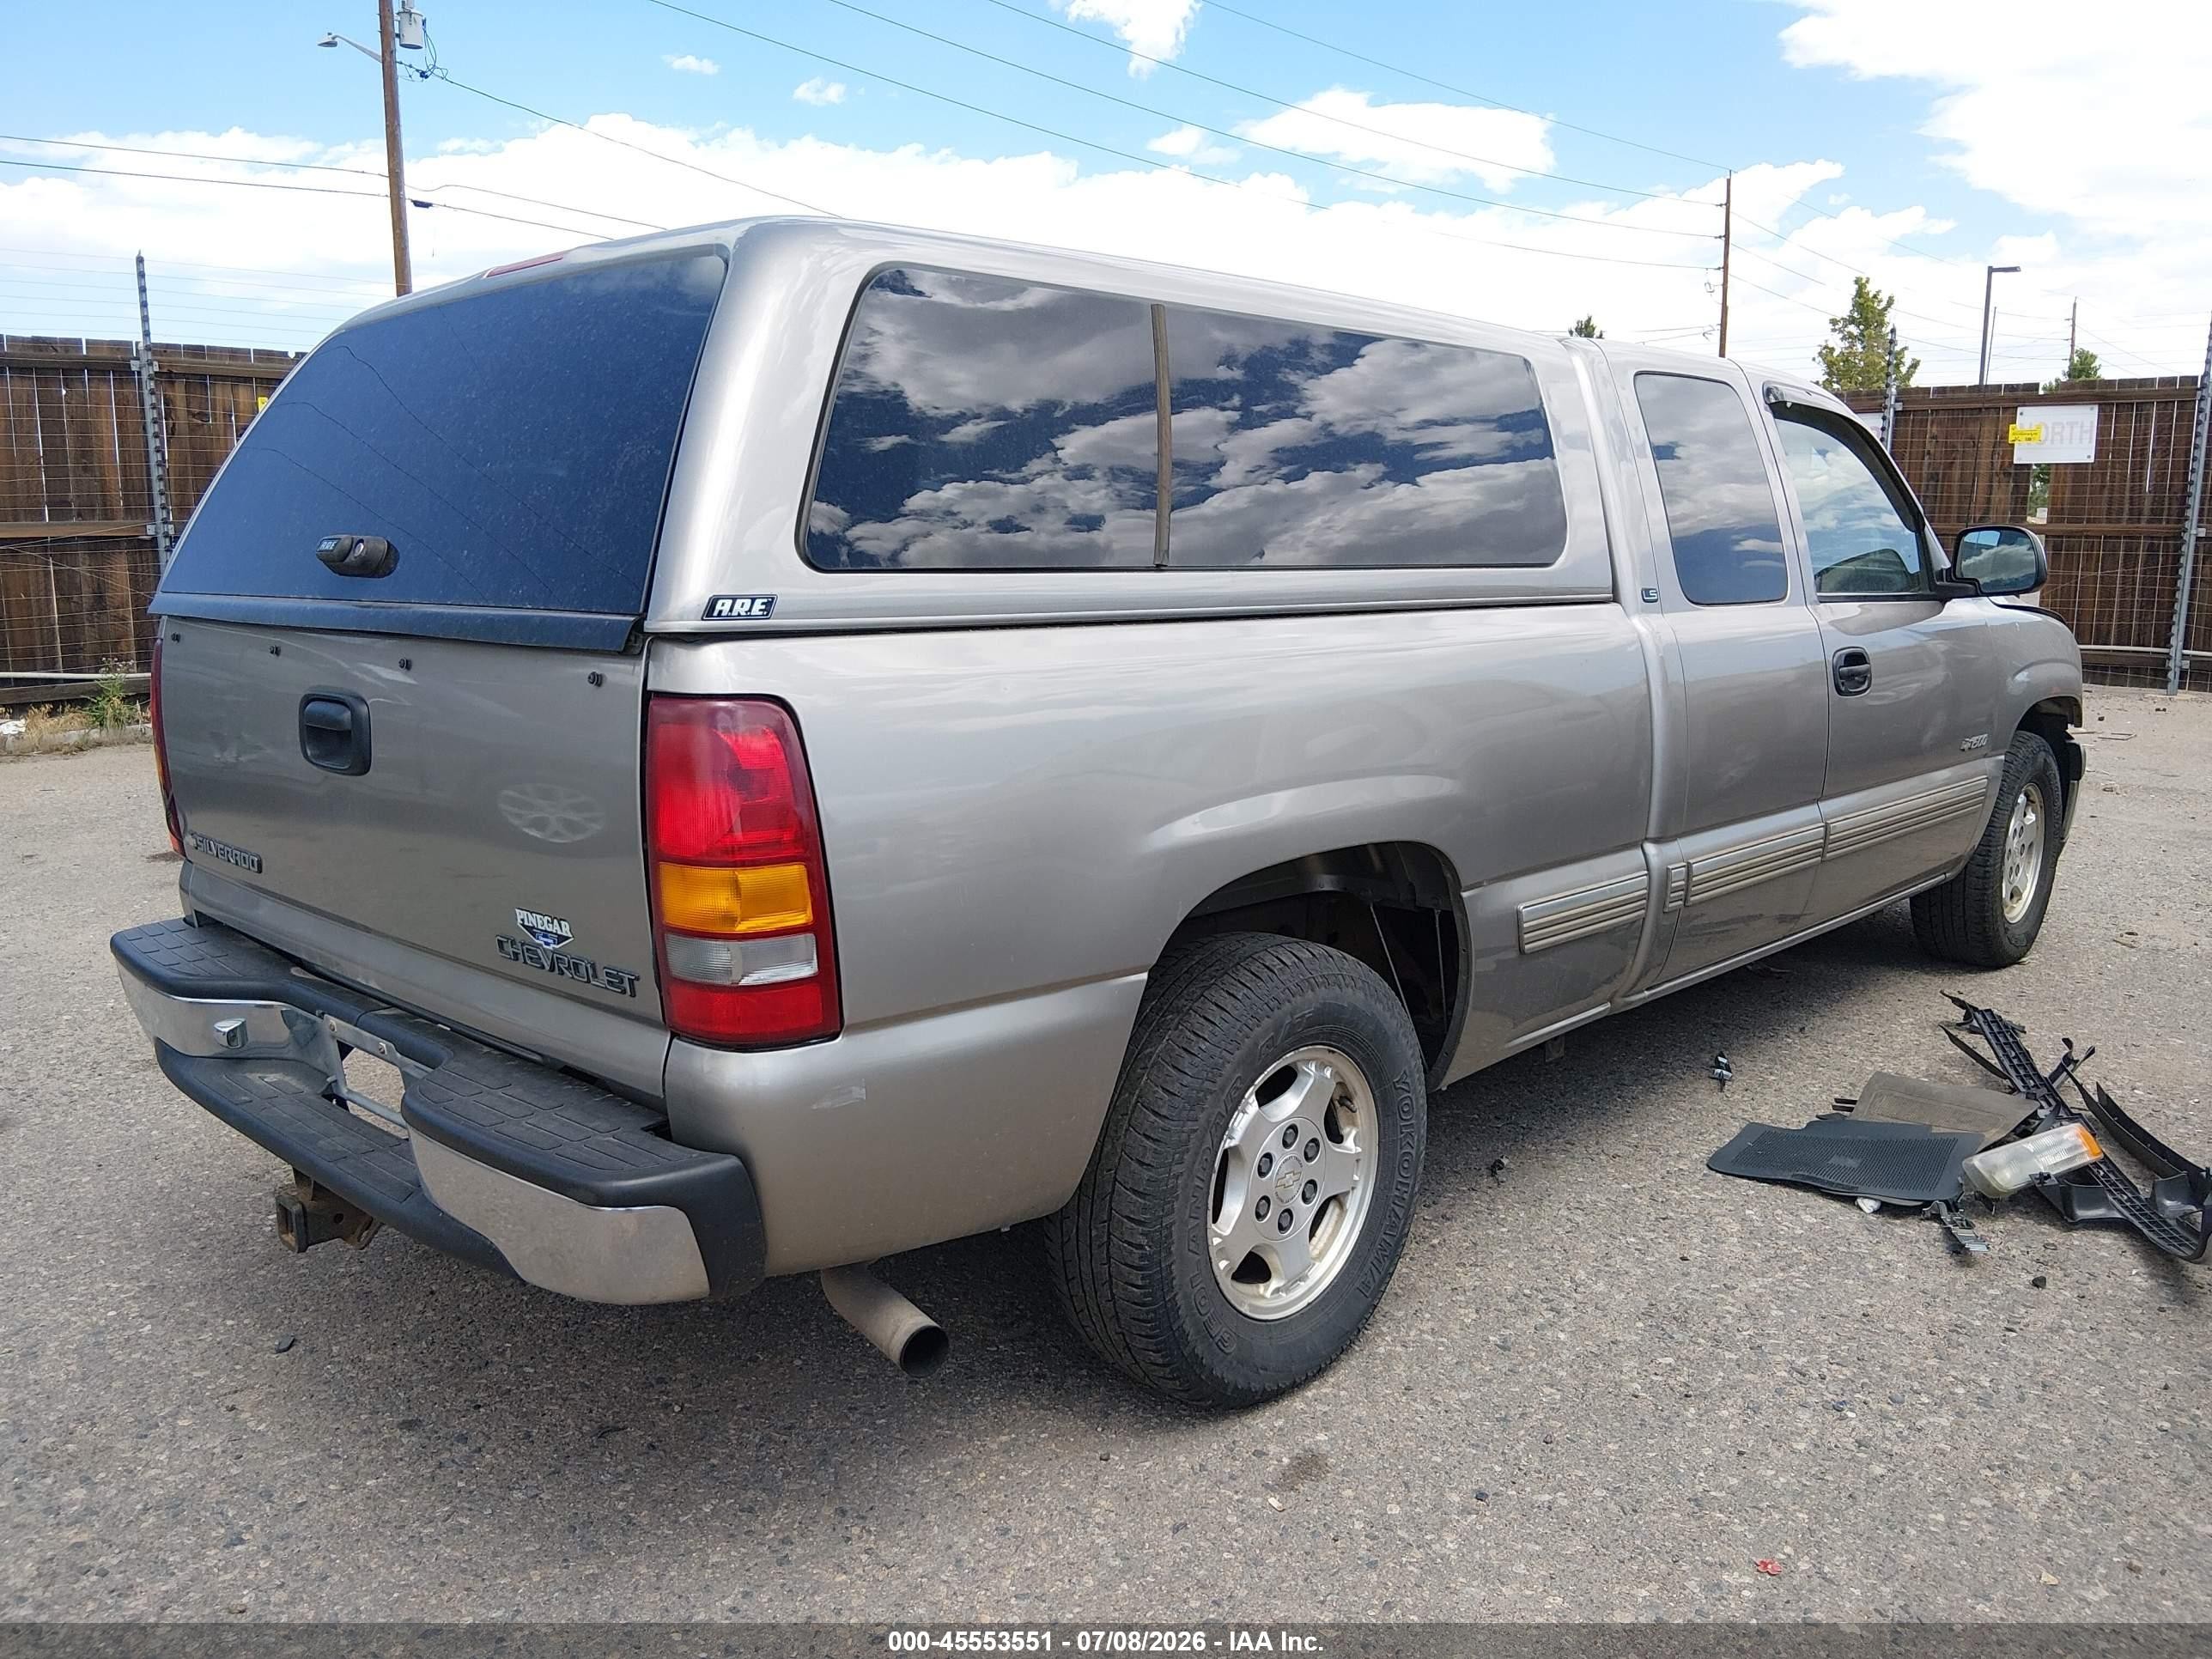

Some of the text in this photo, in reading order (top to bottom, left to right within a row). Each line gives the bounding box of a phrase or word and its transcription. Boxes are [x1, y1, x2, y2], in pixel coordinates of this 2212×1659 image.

[1643, 589, 1658, 599] LS
[196, 835, 261, 873] SILVERADO
[515, 907, 572, 937] PINEGAR
[495, 934, 641, 998] CHEVROLET
[1357, 1072, 1417, 1299] YOKOHAMA
